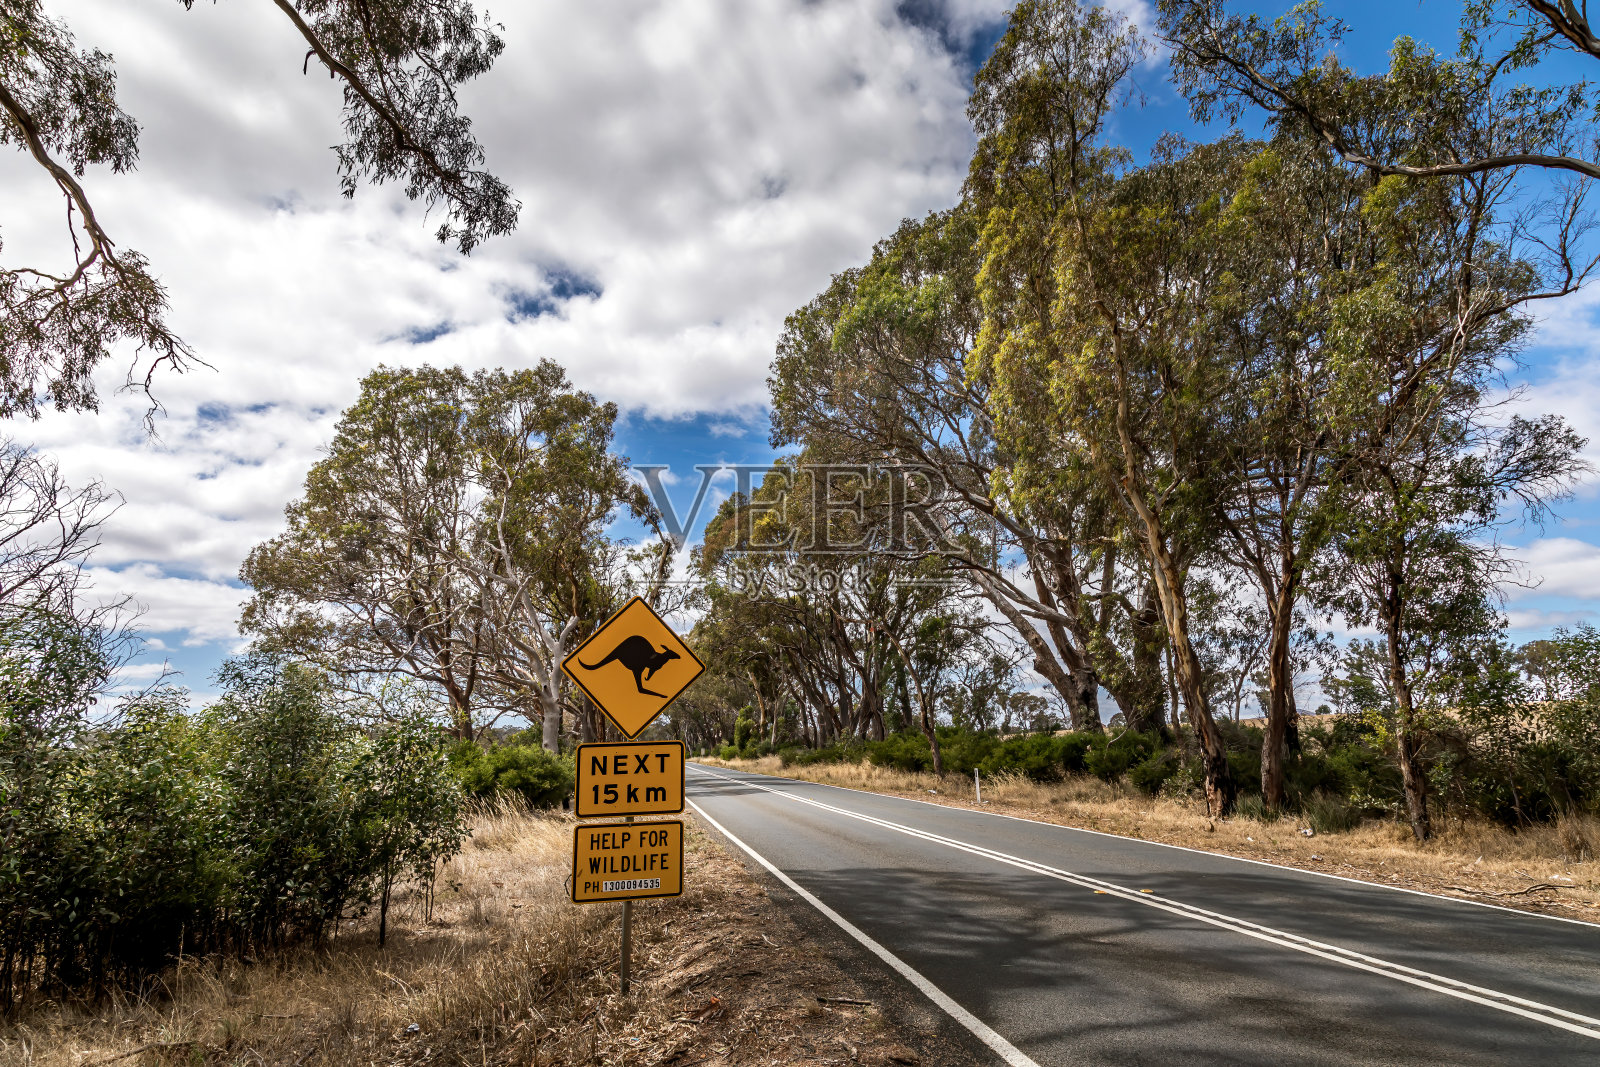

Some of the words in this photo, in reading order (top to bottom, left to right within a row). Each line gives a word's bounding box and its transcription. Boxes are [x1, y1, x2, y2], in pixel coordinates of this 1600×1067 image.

[591, 754, 670, 776] NEXT
[590, 832, 631, 850] HELP
[639, 830, 669, 848] FOR
[589, 853, 669, 874] WILDLIFE
[604, 878, 660, 891] 1300094535
